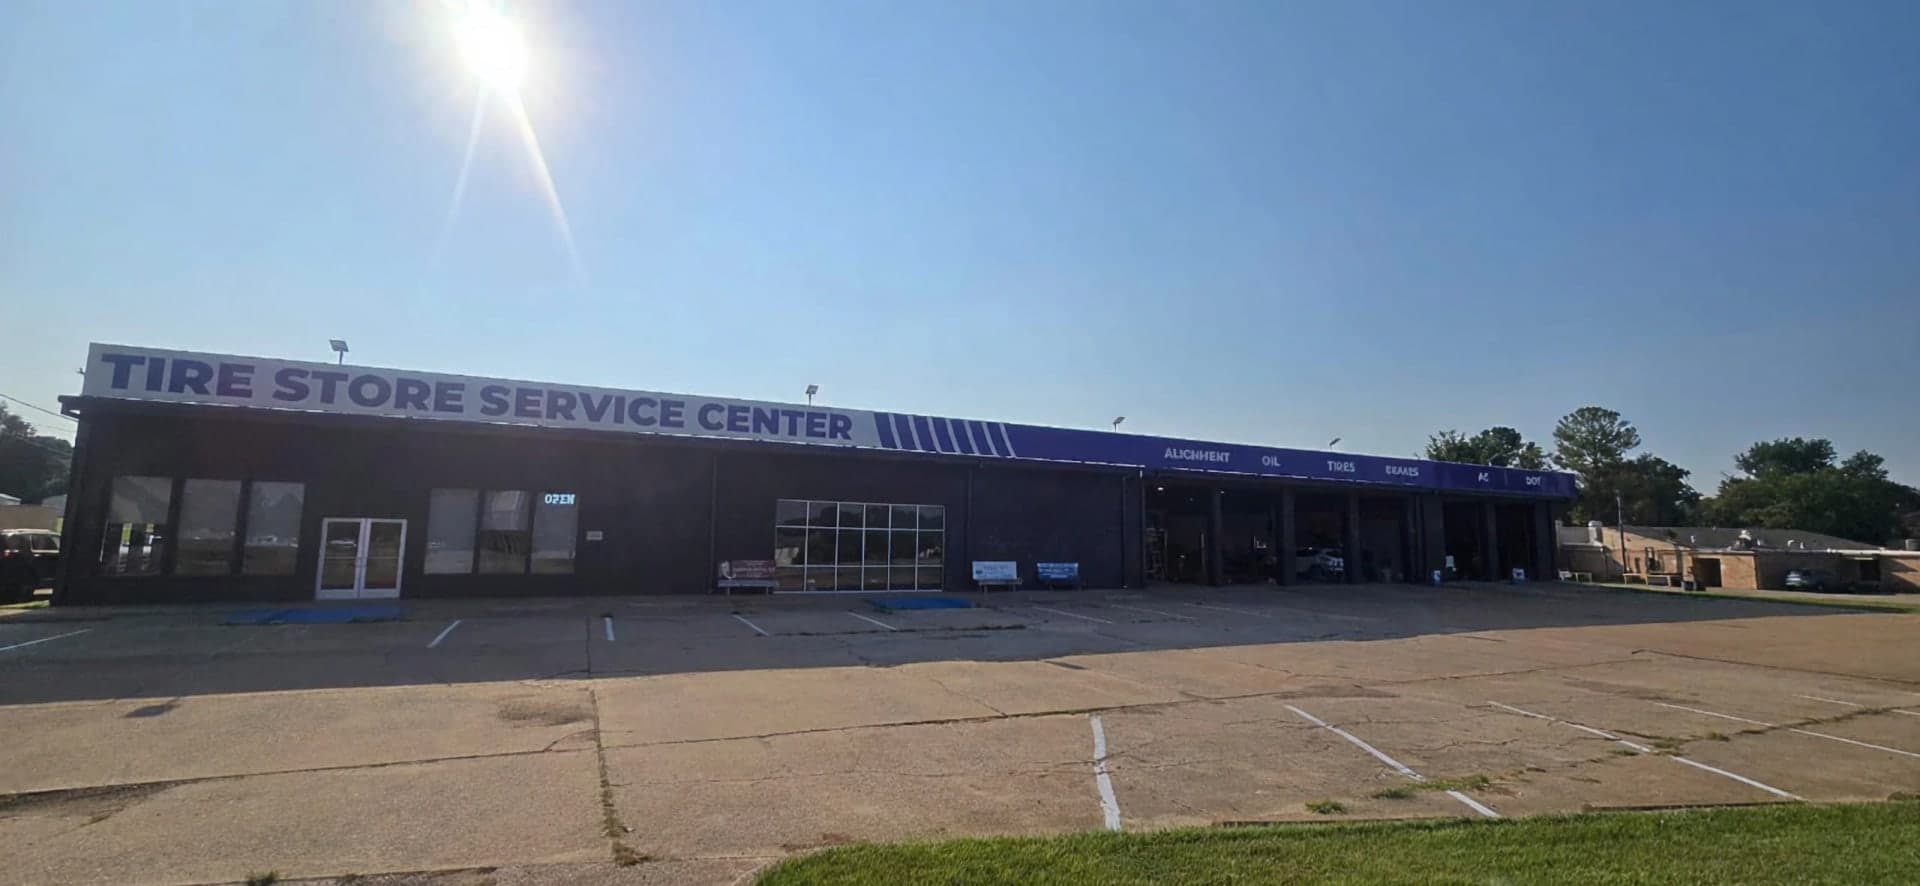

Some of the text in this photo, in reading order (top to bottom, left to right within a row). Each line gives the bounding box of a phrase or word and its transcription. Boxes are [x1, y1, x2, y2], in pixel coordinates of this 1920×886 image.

[102, 353, 852, 440] TIRE STORE SERVICE CENTER
[1261, 455, 1281, 467] OIL
[1327, 461, 1356, 472] TIRES
[544, 493, 576, 505] OPEN
